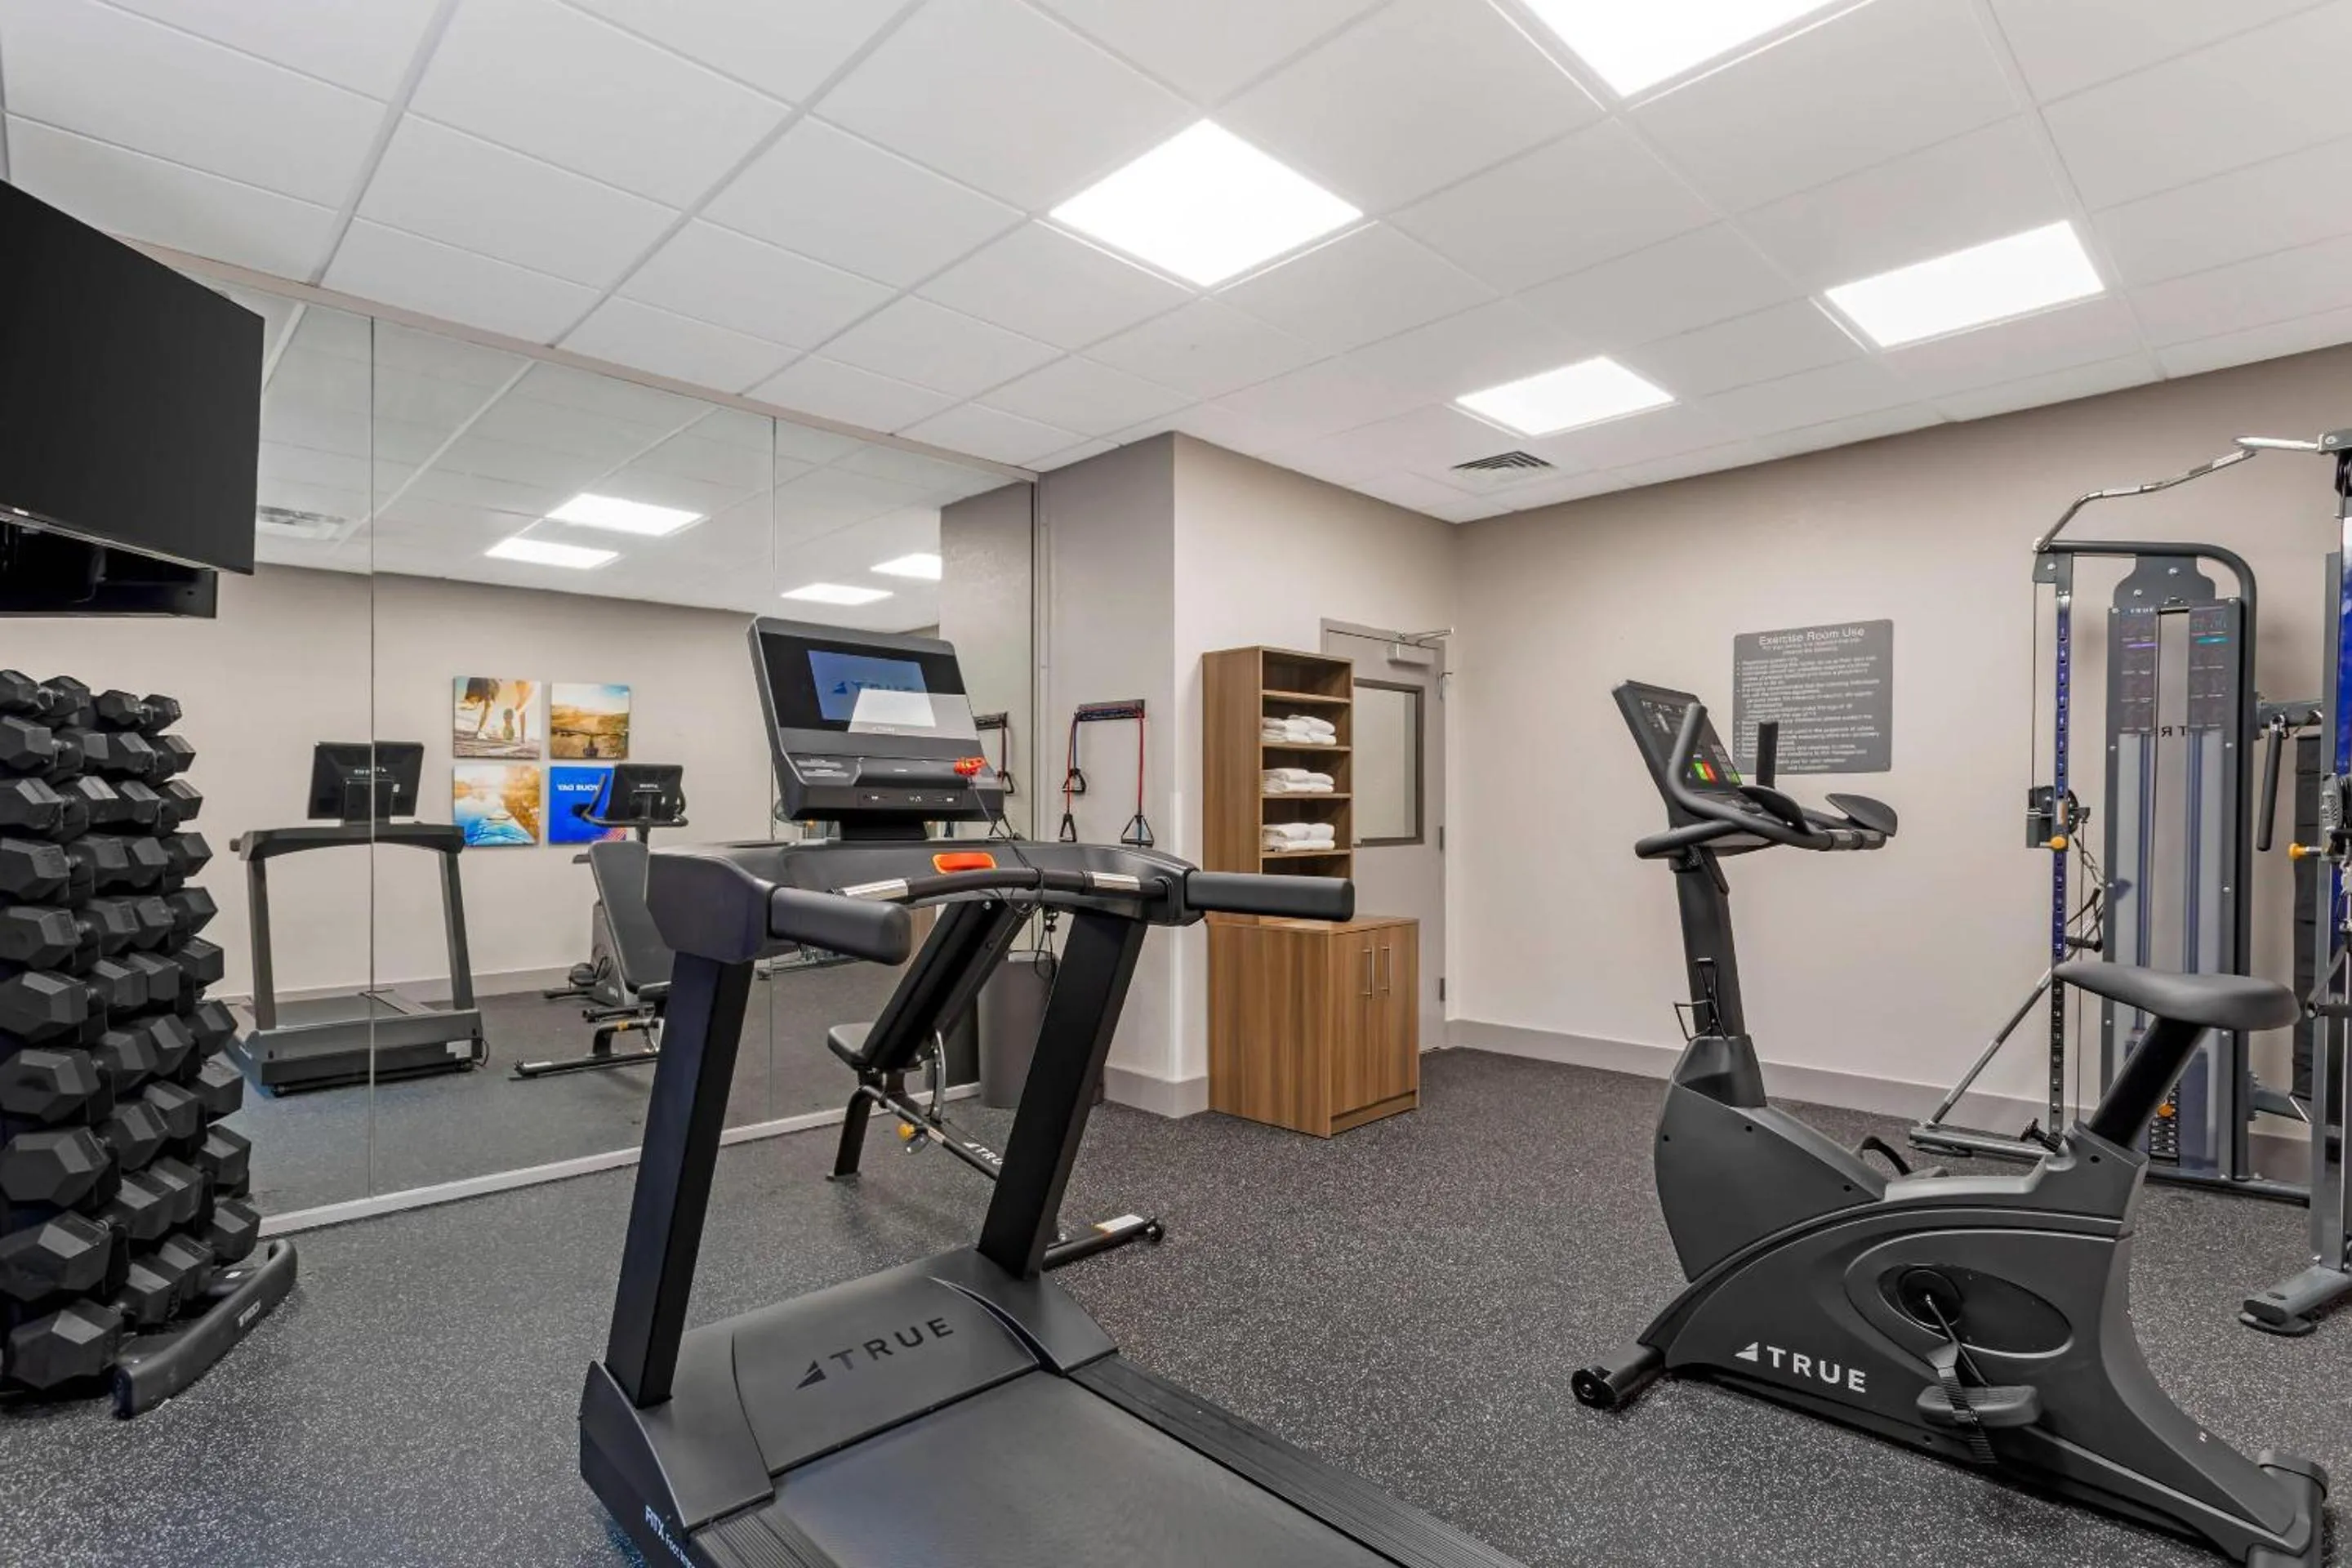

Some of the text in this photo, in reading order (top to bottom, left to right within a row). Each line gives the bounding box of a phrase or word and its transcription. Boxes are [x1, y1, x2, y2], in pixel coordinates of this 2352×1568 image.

[1759, 635, 1803, 646] Exercise
[1807, 630, 1839, 641] Room
[1842, 627, 1864, 638] Use
[975, 1147, 1004, 1165] TRU
[828, 1317, 954, 1371] TRUE
[1766, 1345, 1866, 1393] TRUE
